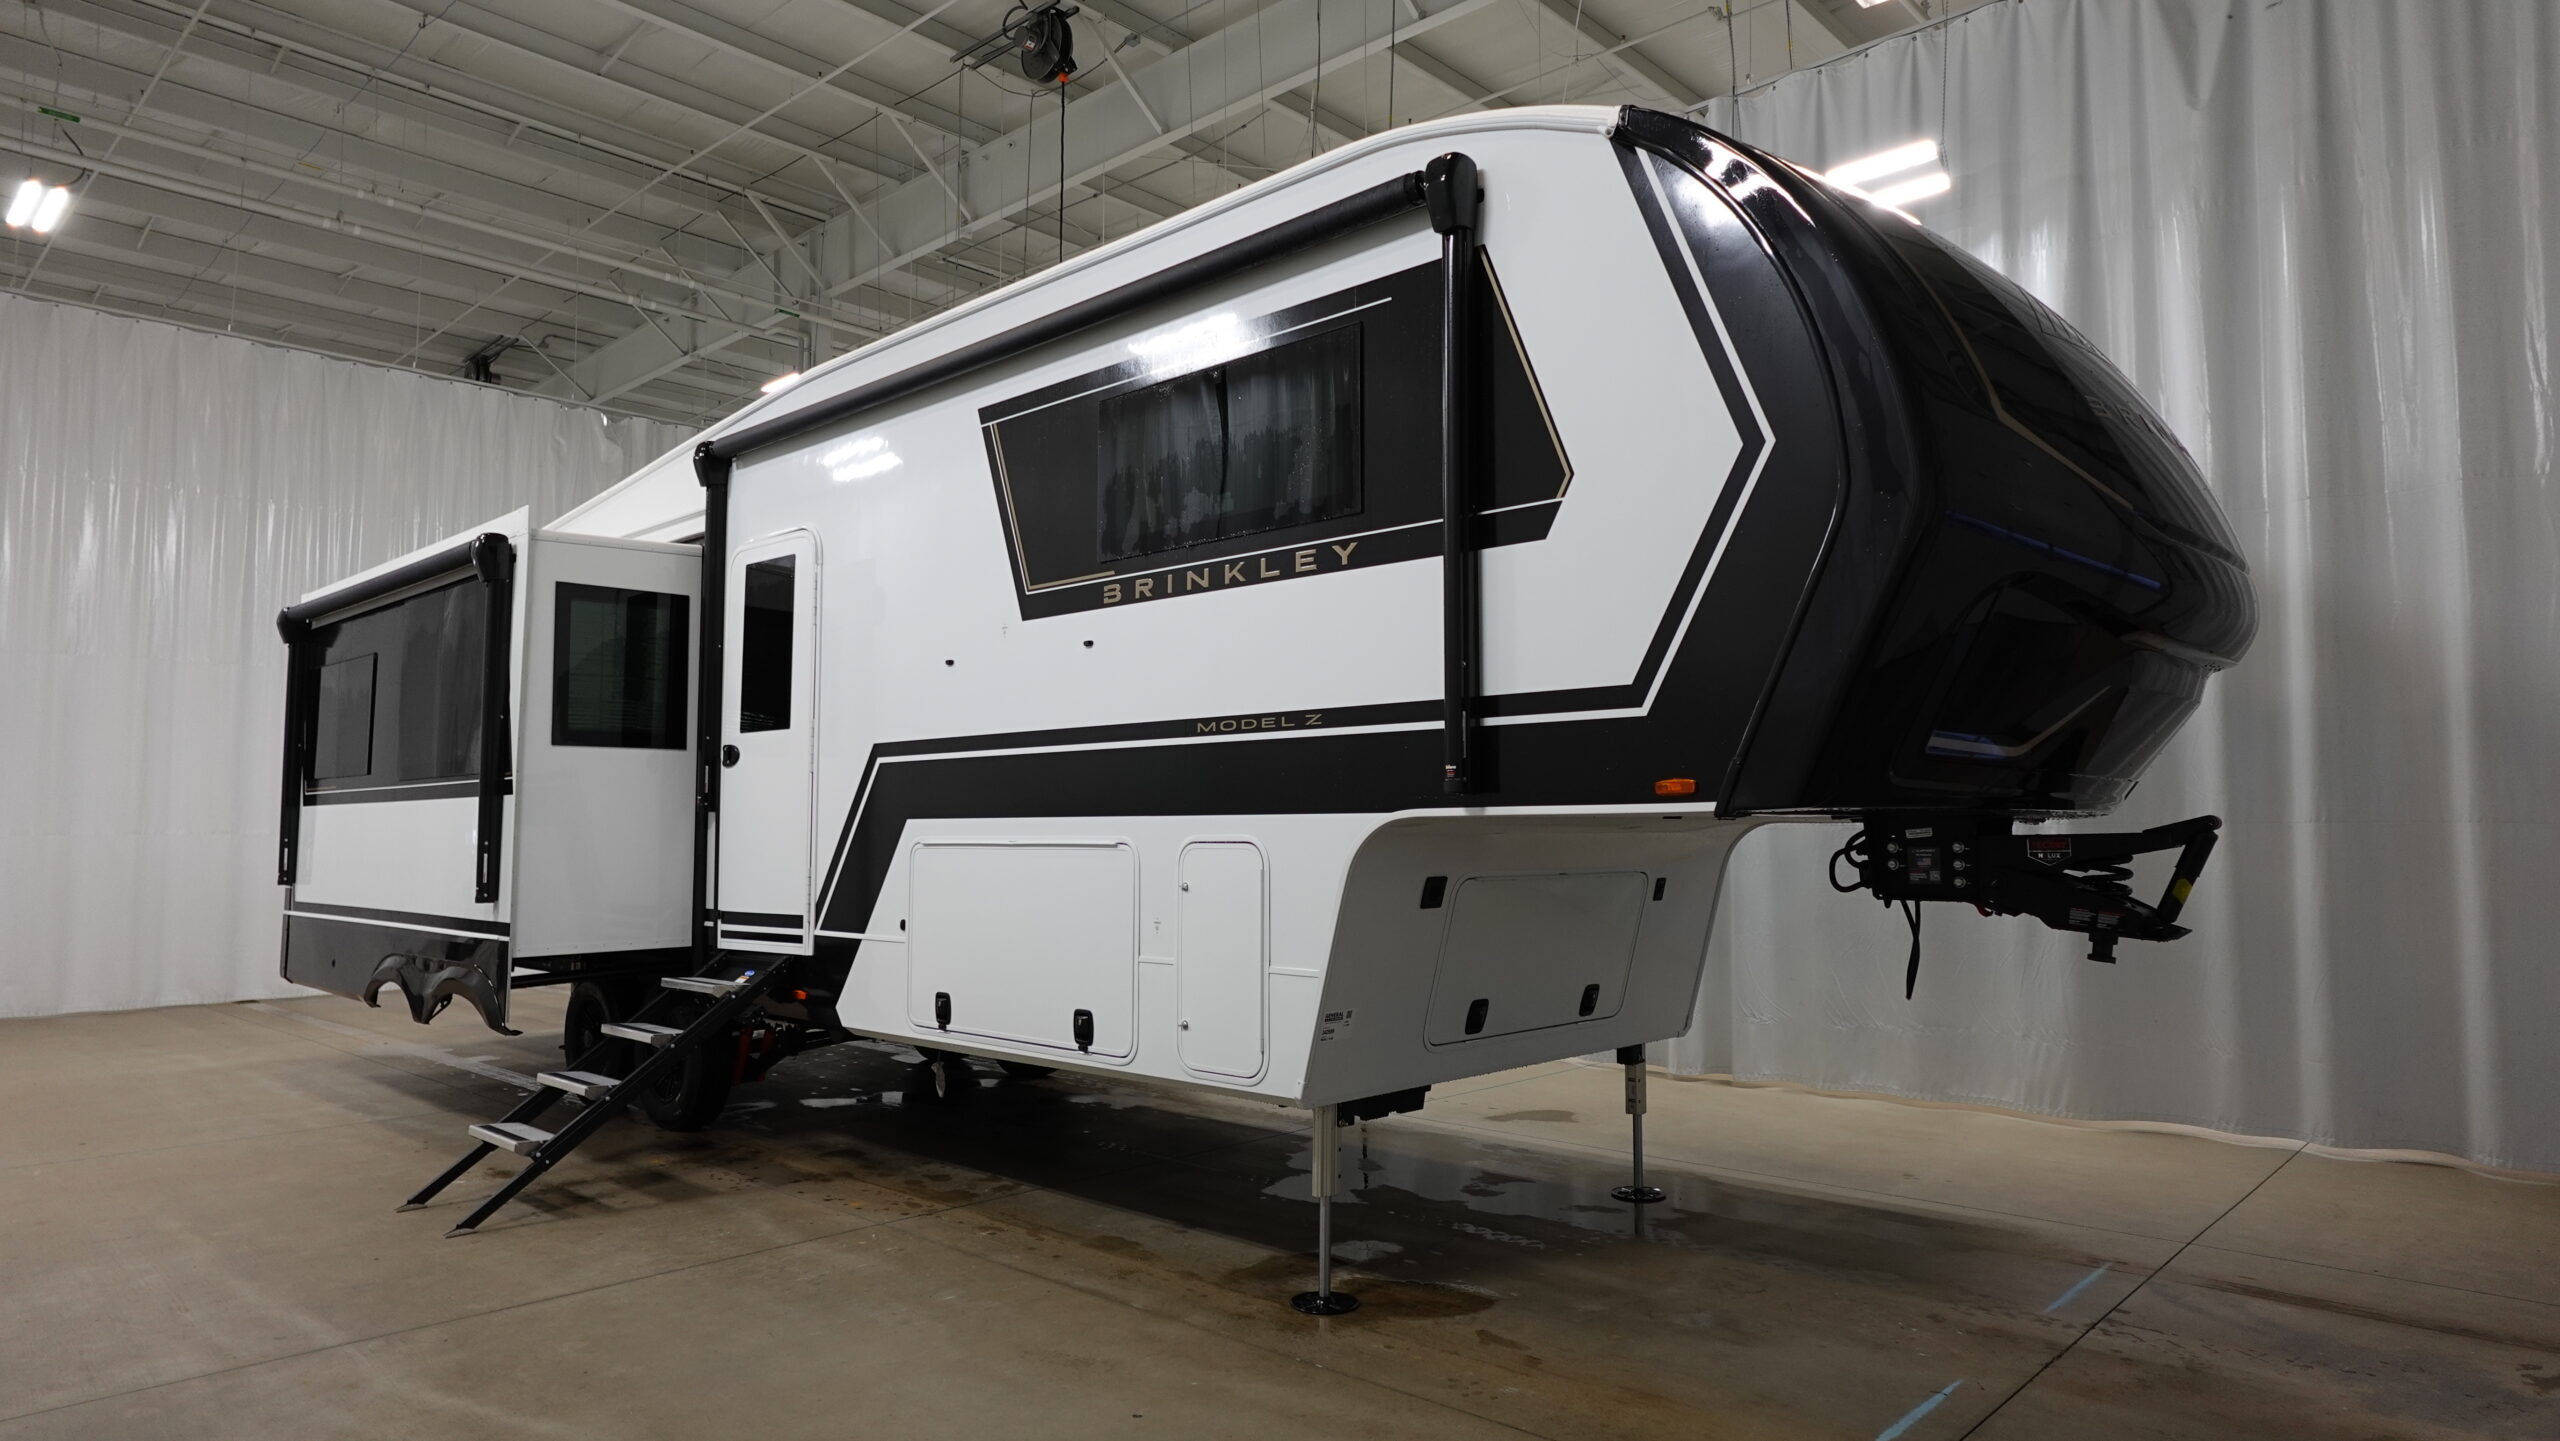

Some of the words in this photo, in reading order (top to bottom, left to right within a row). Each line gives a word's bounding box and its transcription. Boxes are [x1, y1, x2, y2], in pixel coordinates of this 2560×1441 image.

[1103, 541, 1359, 604] BRINKLEY
[1197, 716, 1295, 733] MODEL
[1305, 713, 1322, 726] Z
